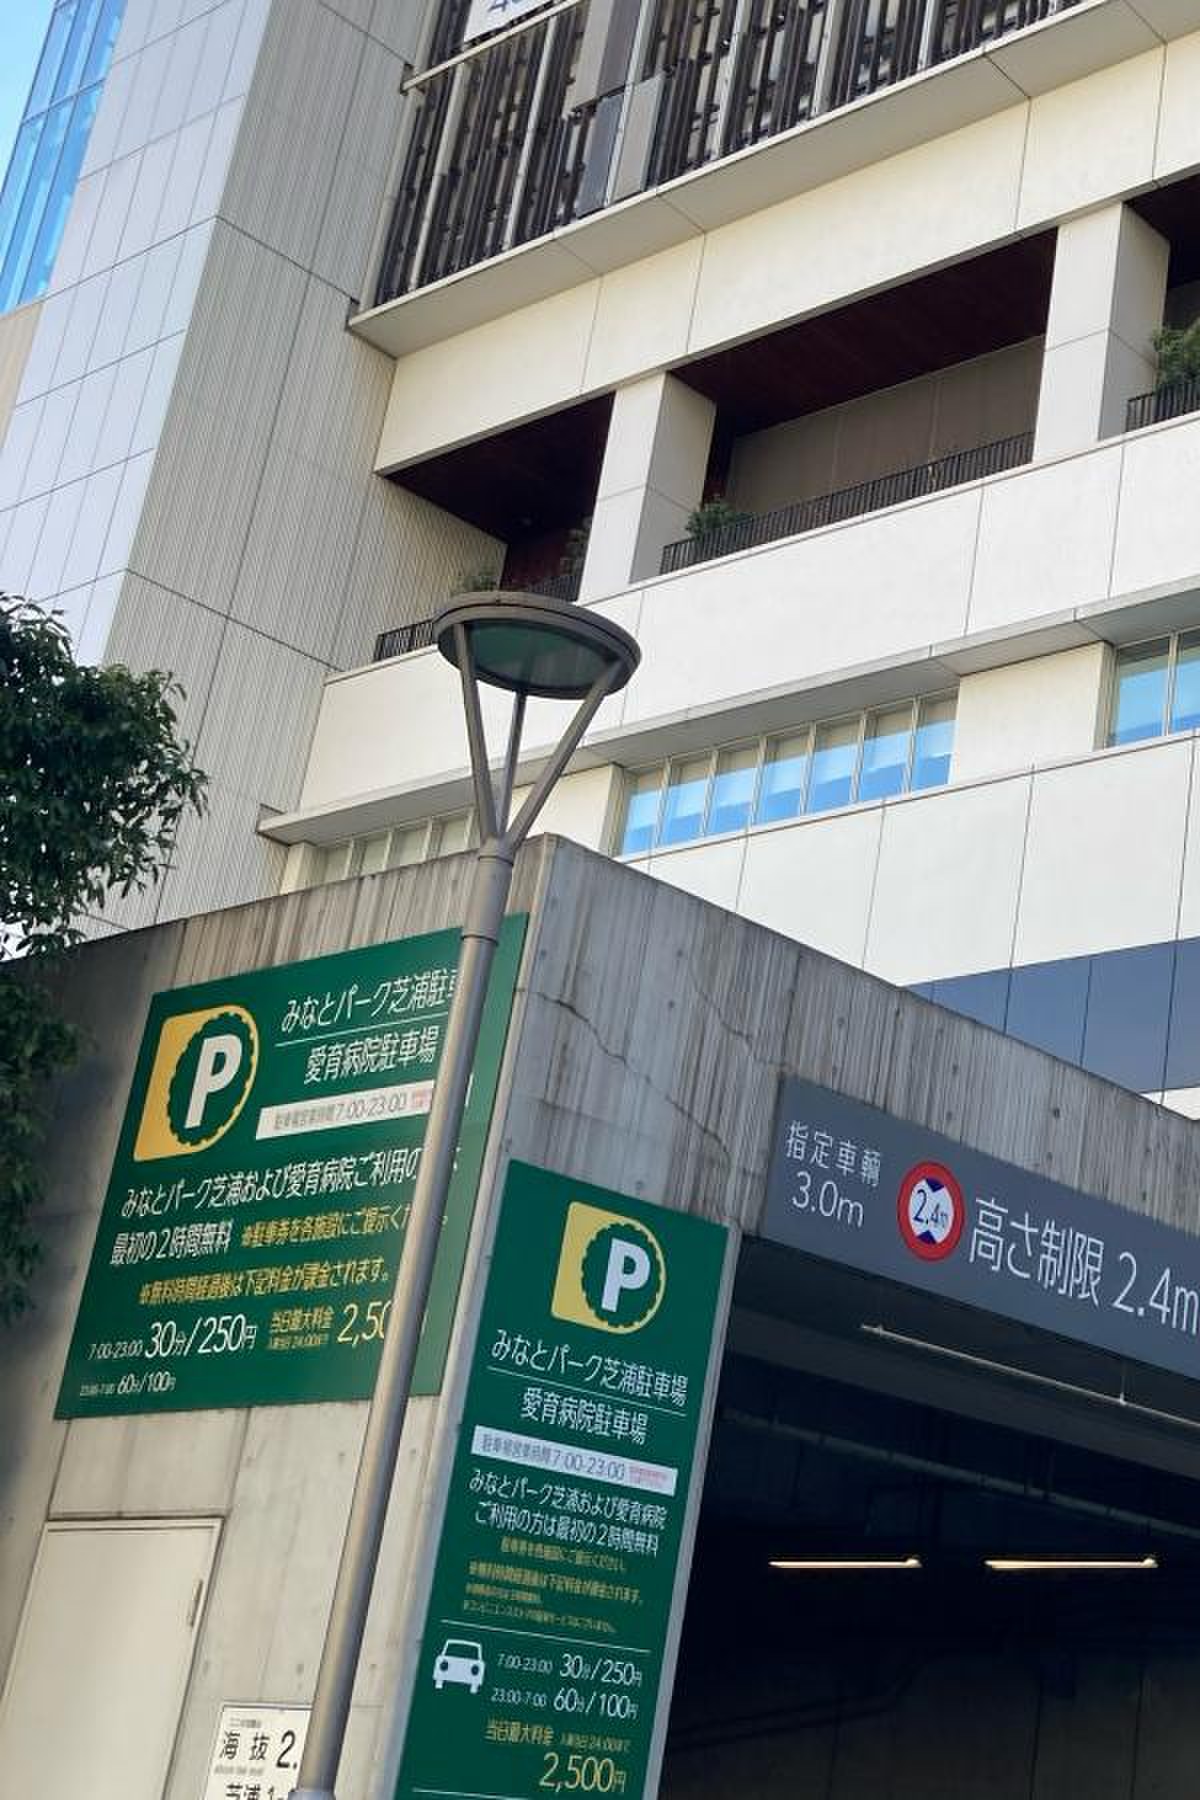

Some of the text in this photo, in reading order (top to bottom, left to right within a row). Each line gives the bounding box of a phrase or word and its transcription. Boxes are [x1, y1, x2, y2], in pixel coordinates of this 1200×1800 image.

[184, 1034, 242, 1129] P
[303, 1025, 439, 1085] 愛育病院駐車場
[791, 1170, 865, 1228] 3.0m
[601, 1237, 651, 1313] P
[969, 1196, 1199, 1335] 高さ制限 2.4m
[491, 1328, 688, 1407] みなとパーク芝浦駐車場
[520, 1386, 649, 1446] 愛育病院駐車場
[539, 1751, 627, 1794] 2,500円
